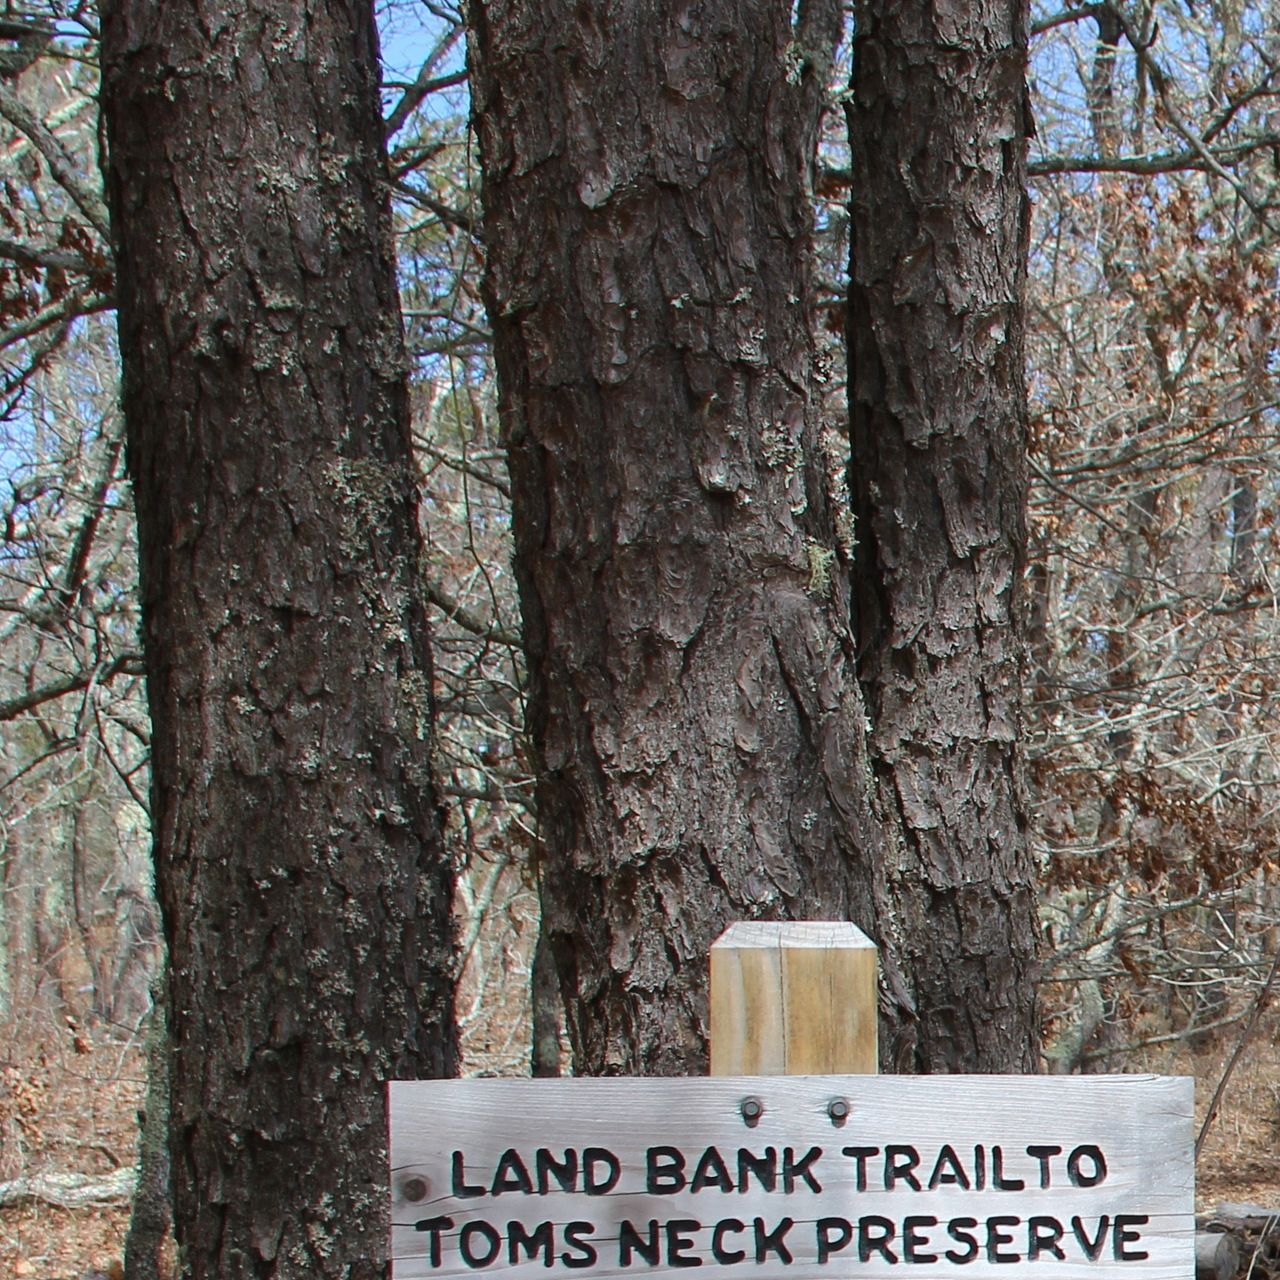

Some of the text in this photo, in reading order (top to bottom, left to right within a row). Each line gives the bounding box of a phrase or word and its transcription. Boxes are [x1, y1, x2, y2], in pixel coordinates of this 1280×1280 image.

[451, 1144, 1107, 1198] LAND BANK TRAIL TO
[415, 1214, 1149, 1270] TOMS NECK PRESERVE
